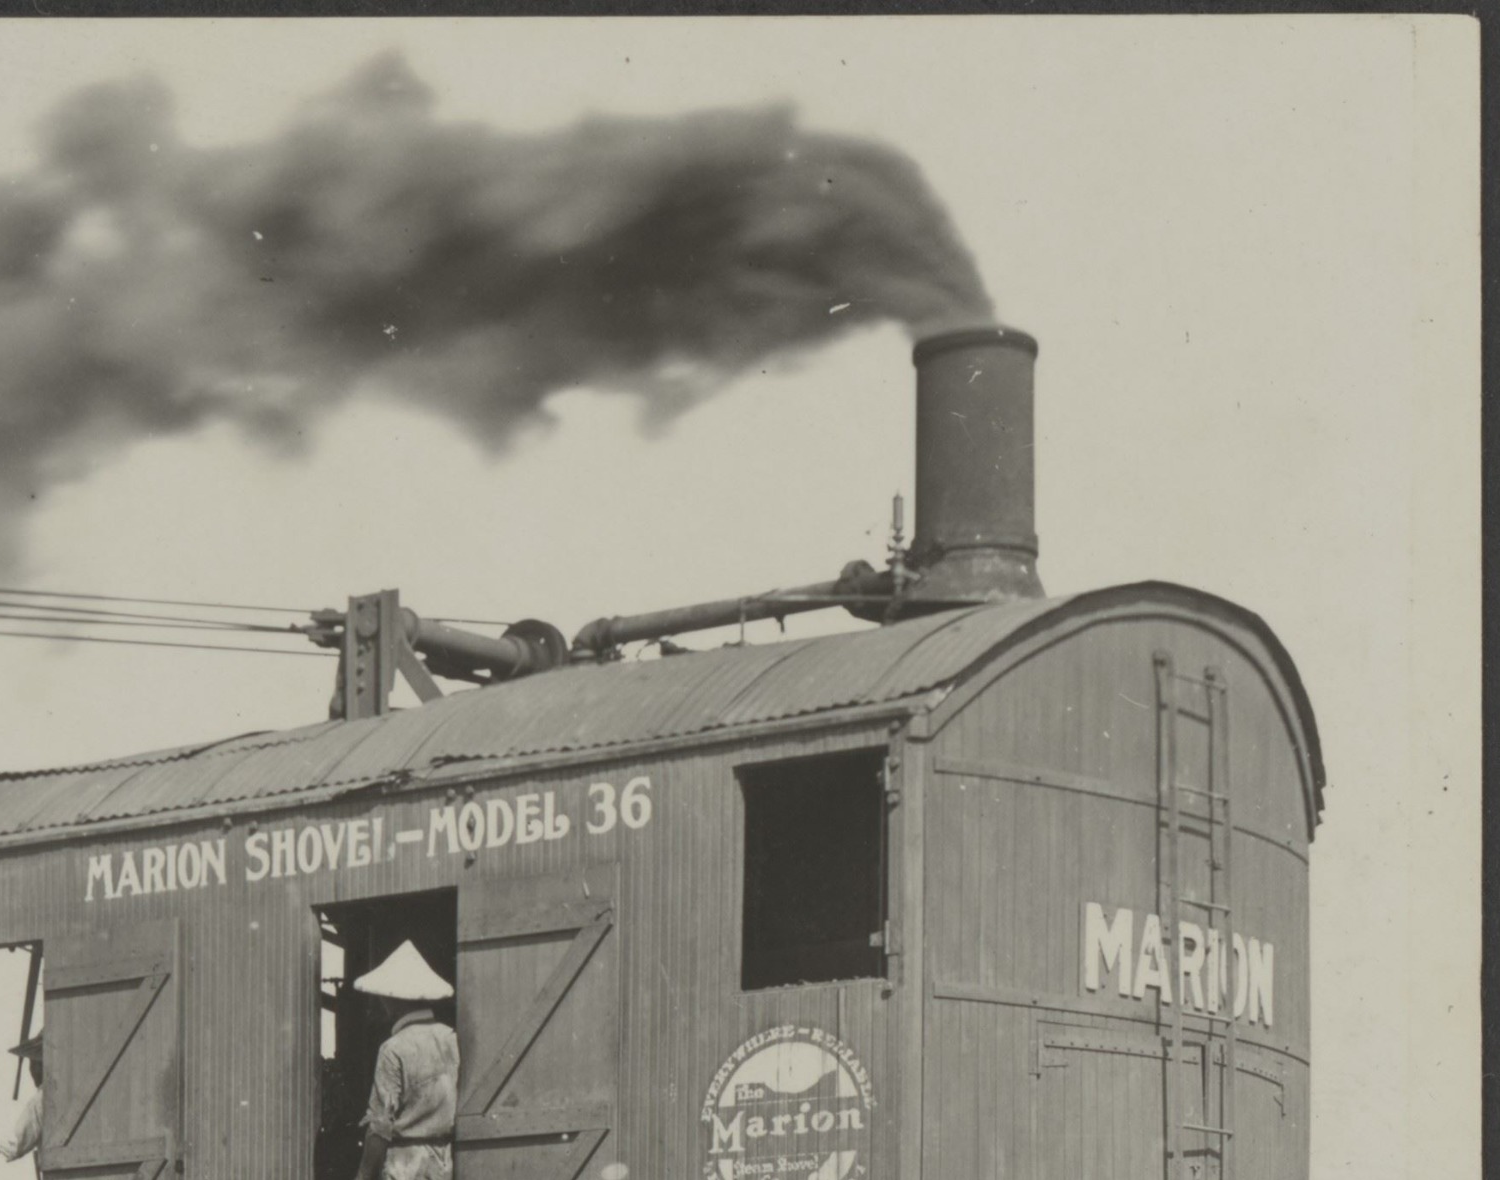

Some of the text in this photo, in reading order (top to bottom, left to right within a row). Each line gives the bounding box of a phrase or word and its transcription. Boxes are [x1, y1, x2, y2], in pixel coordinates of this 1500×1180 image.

[85, 838, 228, 901] MARION
[586, 776, 654, 836] 36
[1084, 901, 1275, 1028] MARION
[707, 1102, 865, 1154] Marion
